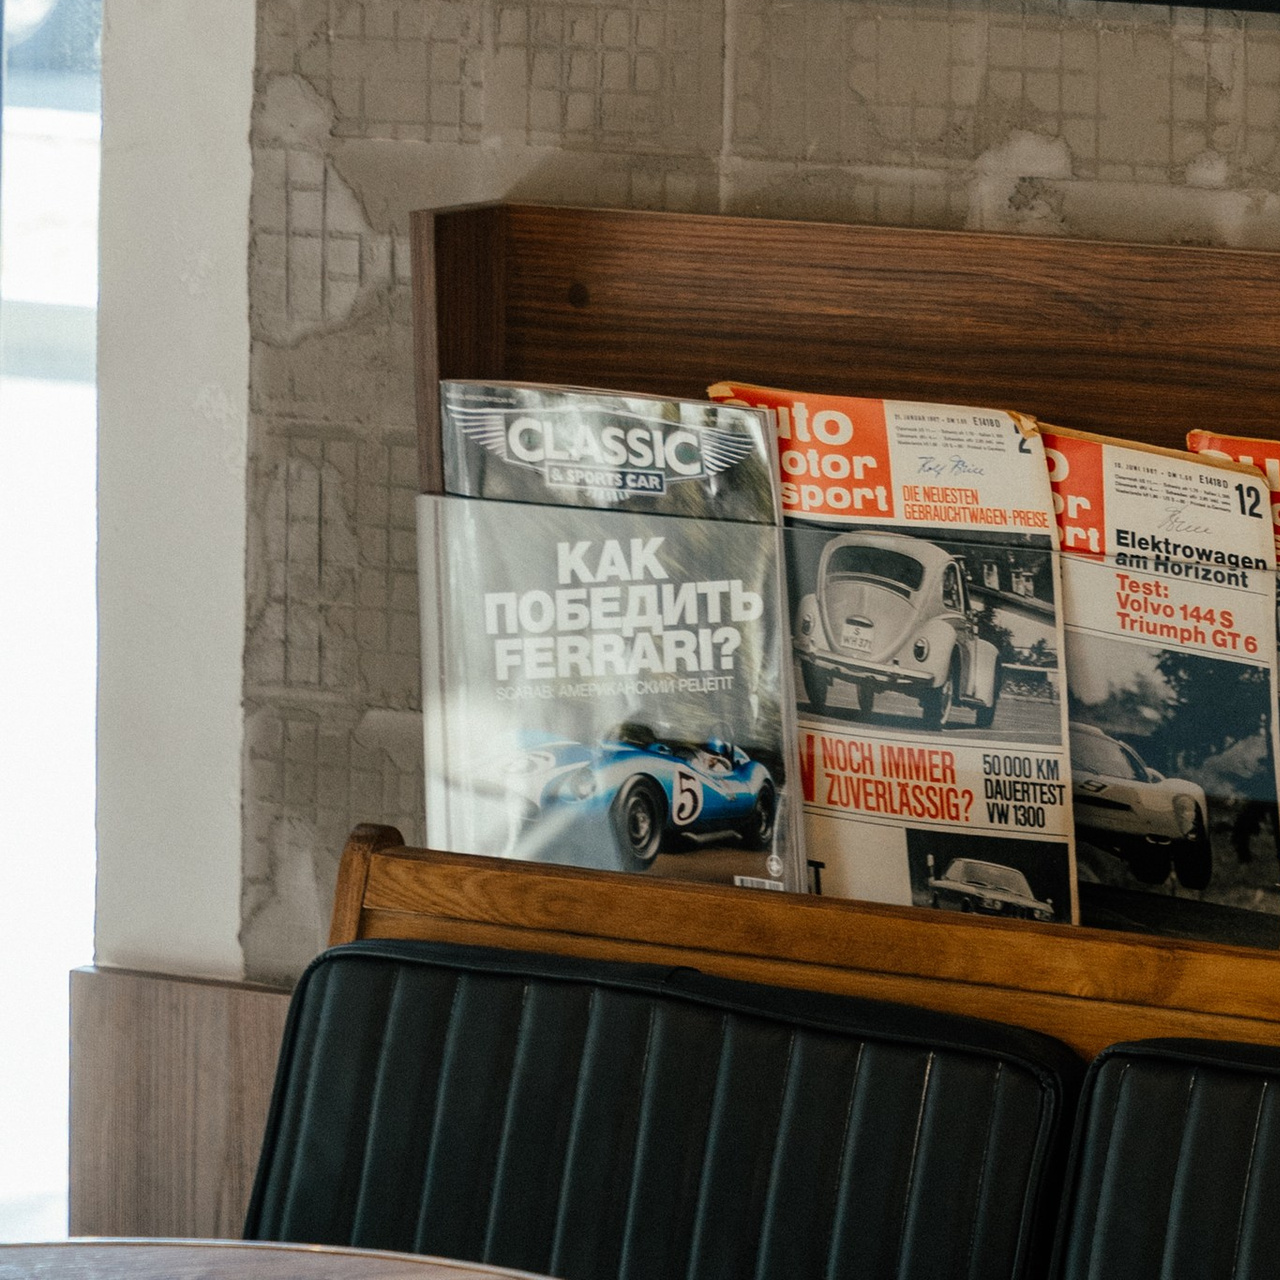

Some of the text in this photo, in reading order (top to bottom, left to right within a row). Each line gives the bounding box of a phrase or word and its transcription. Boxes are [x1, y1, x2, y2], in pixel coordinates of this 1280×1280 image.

[507, 416, 702, 476] CLASSIC
[552, 470, 662, 490] & SPORTS CAR
[781, 449, 878, 480] otor
[903, 485, 979, 505] DIE NEUESTEN
[1235, 483, 1263, 519] 12
[556, 537, 669, 584] КАК
[1115, 528, 1268, 572] Elektrowagen
[1115, 551, 1249, 588] am Horizont
[1115, 573, 1169, 599] Test:
[484, 579, 764, 637] ПОБЕДИТЬ
[1115, 592, 1175, 618] Volvo
[1115, 611, 1259, 654] Triumph GT 6
[495, 627, 742, 681] FERRARI?
[678, 675, 735, 694] РЕЦЕПТ
[821, 736, 874, 776] NOCH
[880, 744, 957, 785] IMMER
[1036, 759, 1060, 781] KM
[677, 770, 699, 822] 5
[824, 772, 975, 822] ZUVERLÄSSIG?
[984, 778, 1066, 806] DAUERTEST
[986, 802, 1045, 828] VW 1300
